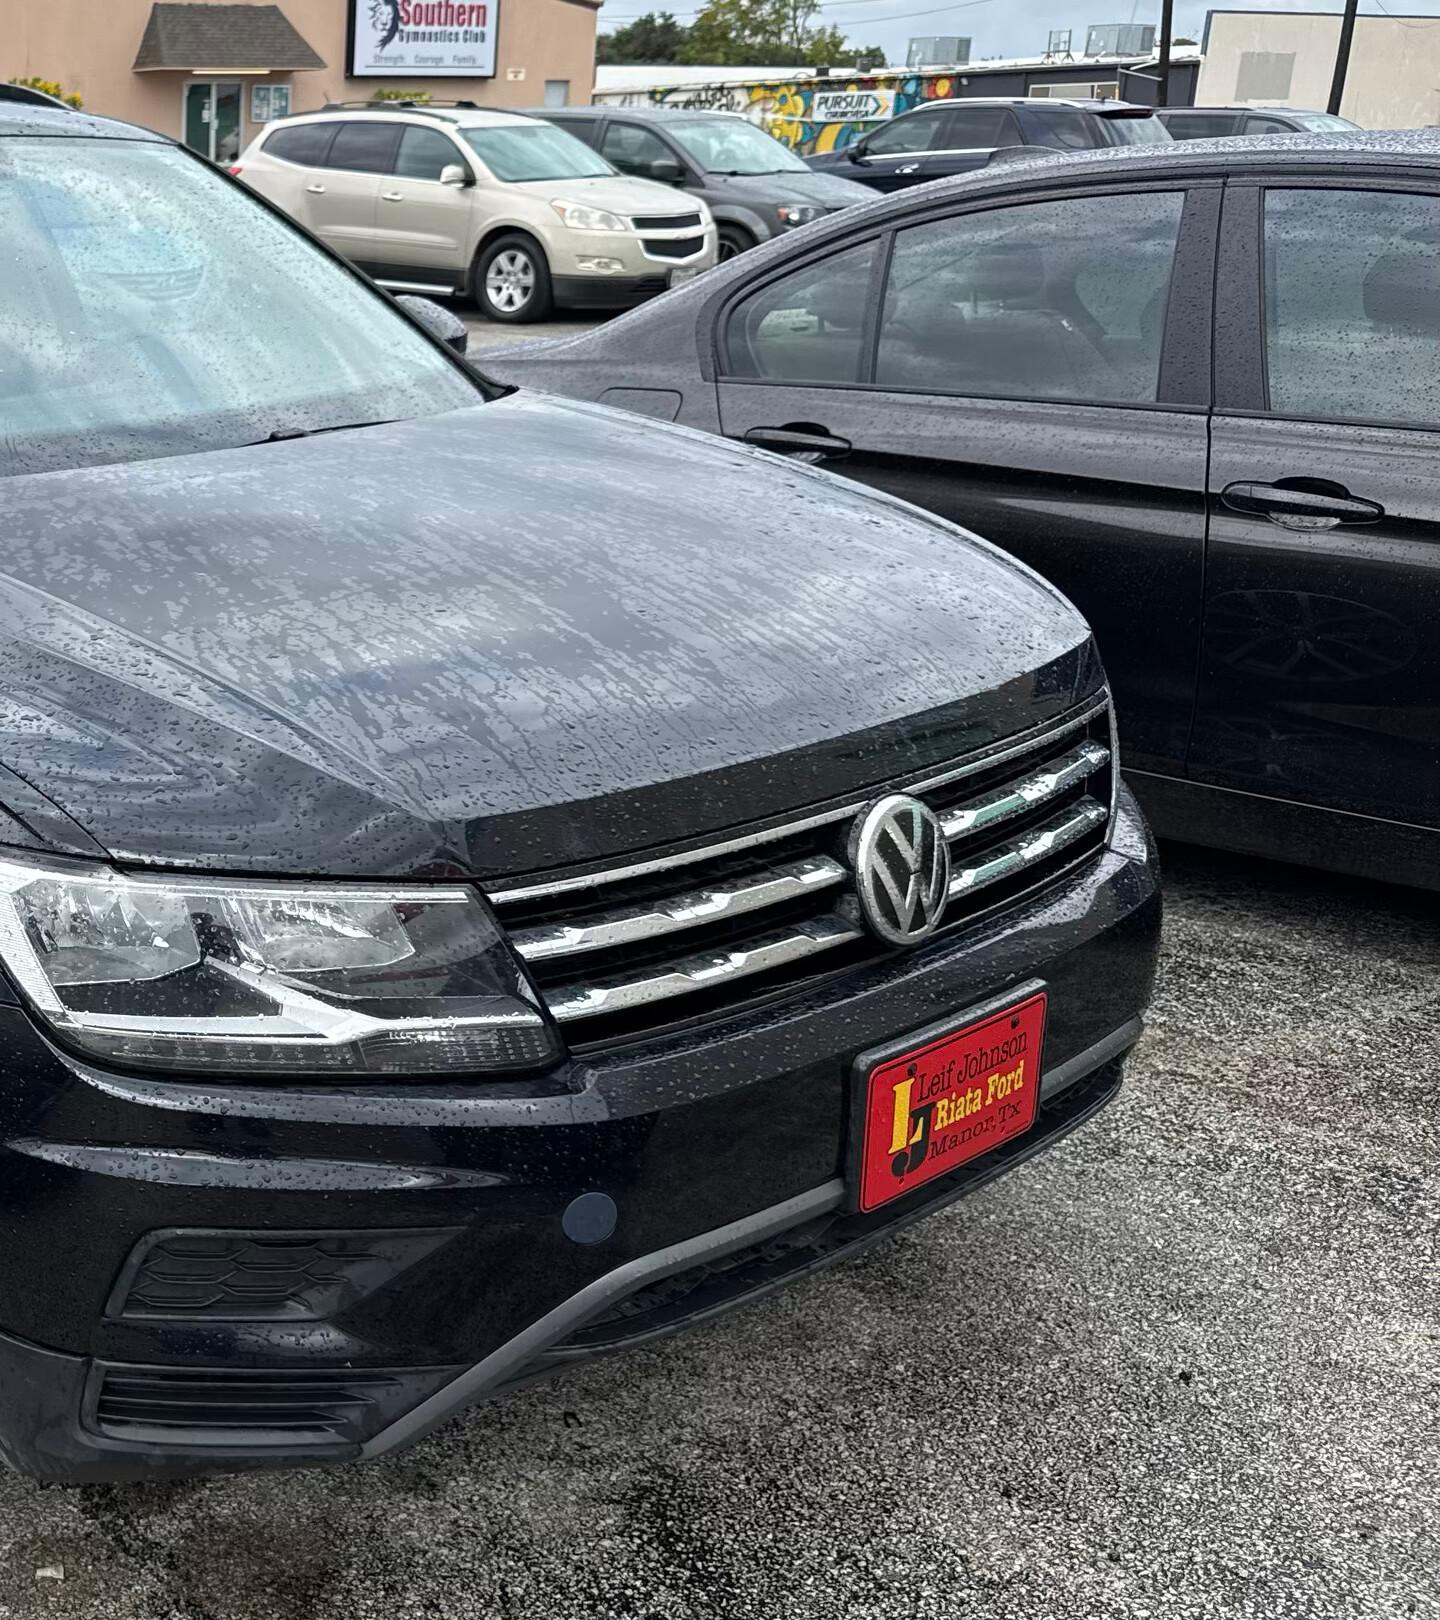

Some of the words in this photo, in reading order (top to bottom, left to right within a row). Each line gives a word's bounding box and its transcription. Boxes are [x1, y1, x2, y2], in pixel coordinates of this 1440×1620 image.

[400, 0, 486, 27] Southern
[398, 29, 459, 43] Gymnastics
[462, 30, 485, 43] Club
[817, 94, 872, 111] PURSUIT
[917, 1061, 956, 1103] Leif
[957, 1031, 1028, 1083] Johnson
[934, 1088, 982, 1131] Riata
[985, 1060, 1024, 1106] Ford
